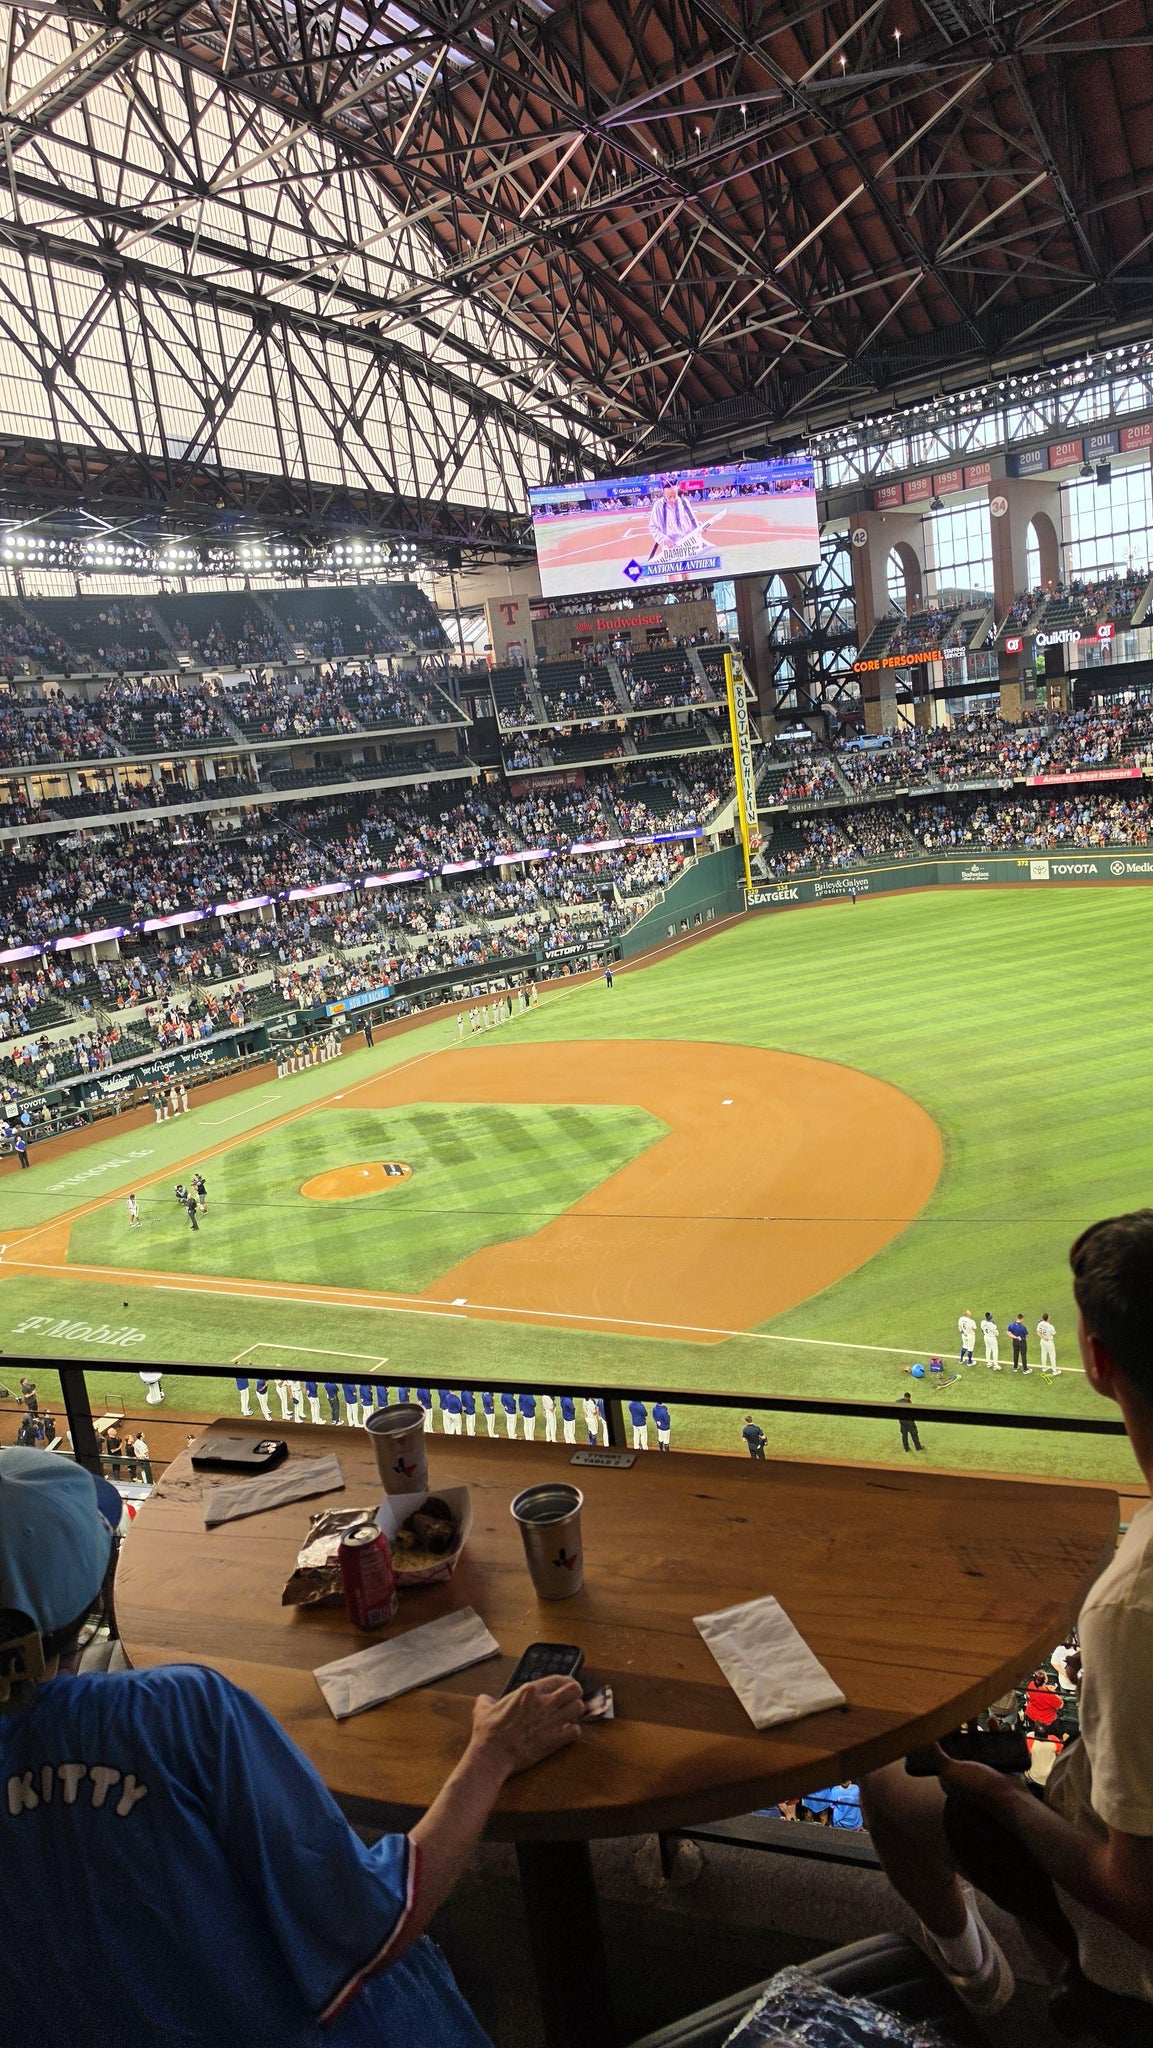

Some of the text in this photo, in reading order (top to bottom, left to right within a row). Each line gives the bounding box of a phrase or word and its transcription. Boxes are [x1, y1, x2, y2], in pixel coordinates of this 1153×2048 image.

[1128, 425, 1150, 438] 2012
[1090, 434, 1111, 448] 2011
[1056, 444, 1076, 456] 2011
[1020, 451, 1040, 464] 2010
[970, 463, 990, 476] 2010
[938, 472, 958, 484] 1999
[878, 487, 896, 498] 1996
[908, 480, 927, 492] 1998
[992, 500, 1006, 513] 34
[854, 532, 866, 543] 42
[647, 558, 716, 575] NATIONAL ANTHEM
[500, 602, 519, 628] T
[596, 614, 663, 630] Budweiser
[1036, 628, 1080, 646] QuikTrip
[1098, 624, 1112, 638] QT
[1006, 640, 1020, 651] QT
[854, 660, 880, 673] CORE
[882, 650, 944, 669] PERSONNEL
[736, 687, 746, 731] ROOT
[740, 738, 749, 748] 4
[1043, 773, 1080, 783] America's
[1100, 770, 1132, 778] Network
[742, 756, 755, 821] CHIKIN
[910, 788, 934, 796] American
[844, 796, 864, 805] SHIFT
[792, 803, 812, 812] SHIFT
[1052, 864, 1098, 874] TOYOTA
[1126, 862, 1153, 872] Medic
[748, 888, 799, 906] SEATGEEK
[544, 944, 582, 959] VICTORY
[191, 1048, 214, 1062] Kroger
[152, 1060, 176, 1075] Kroger
[20, 1098, 47, 1110] TOYOTA
[7, 1763, 148, 1817] KITTY
